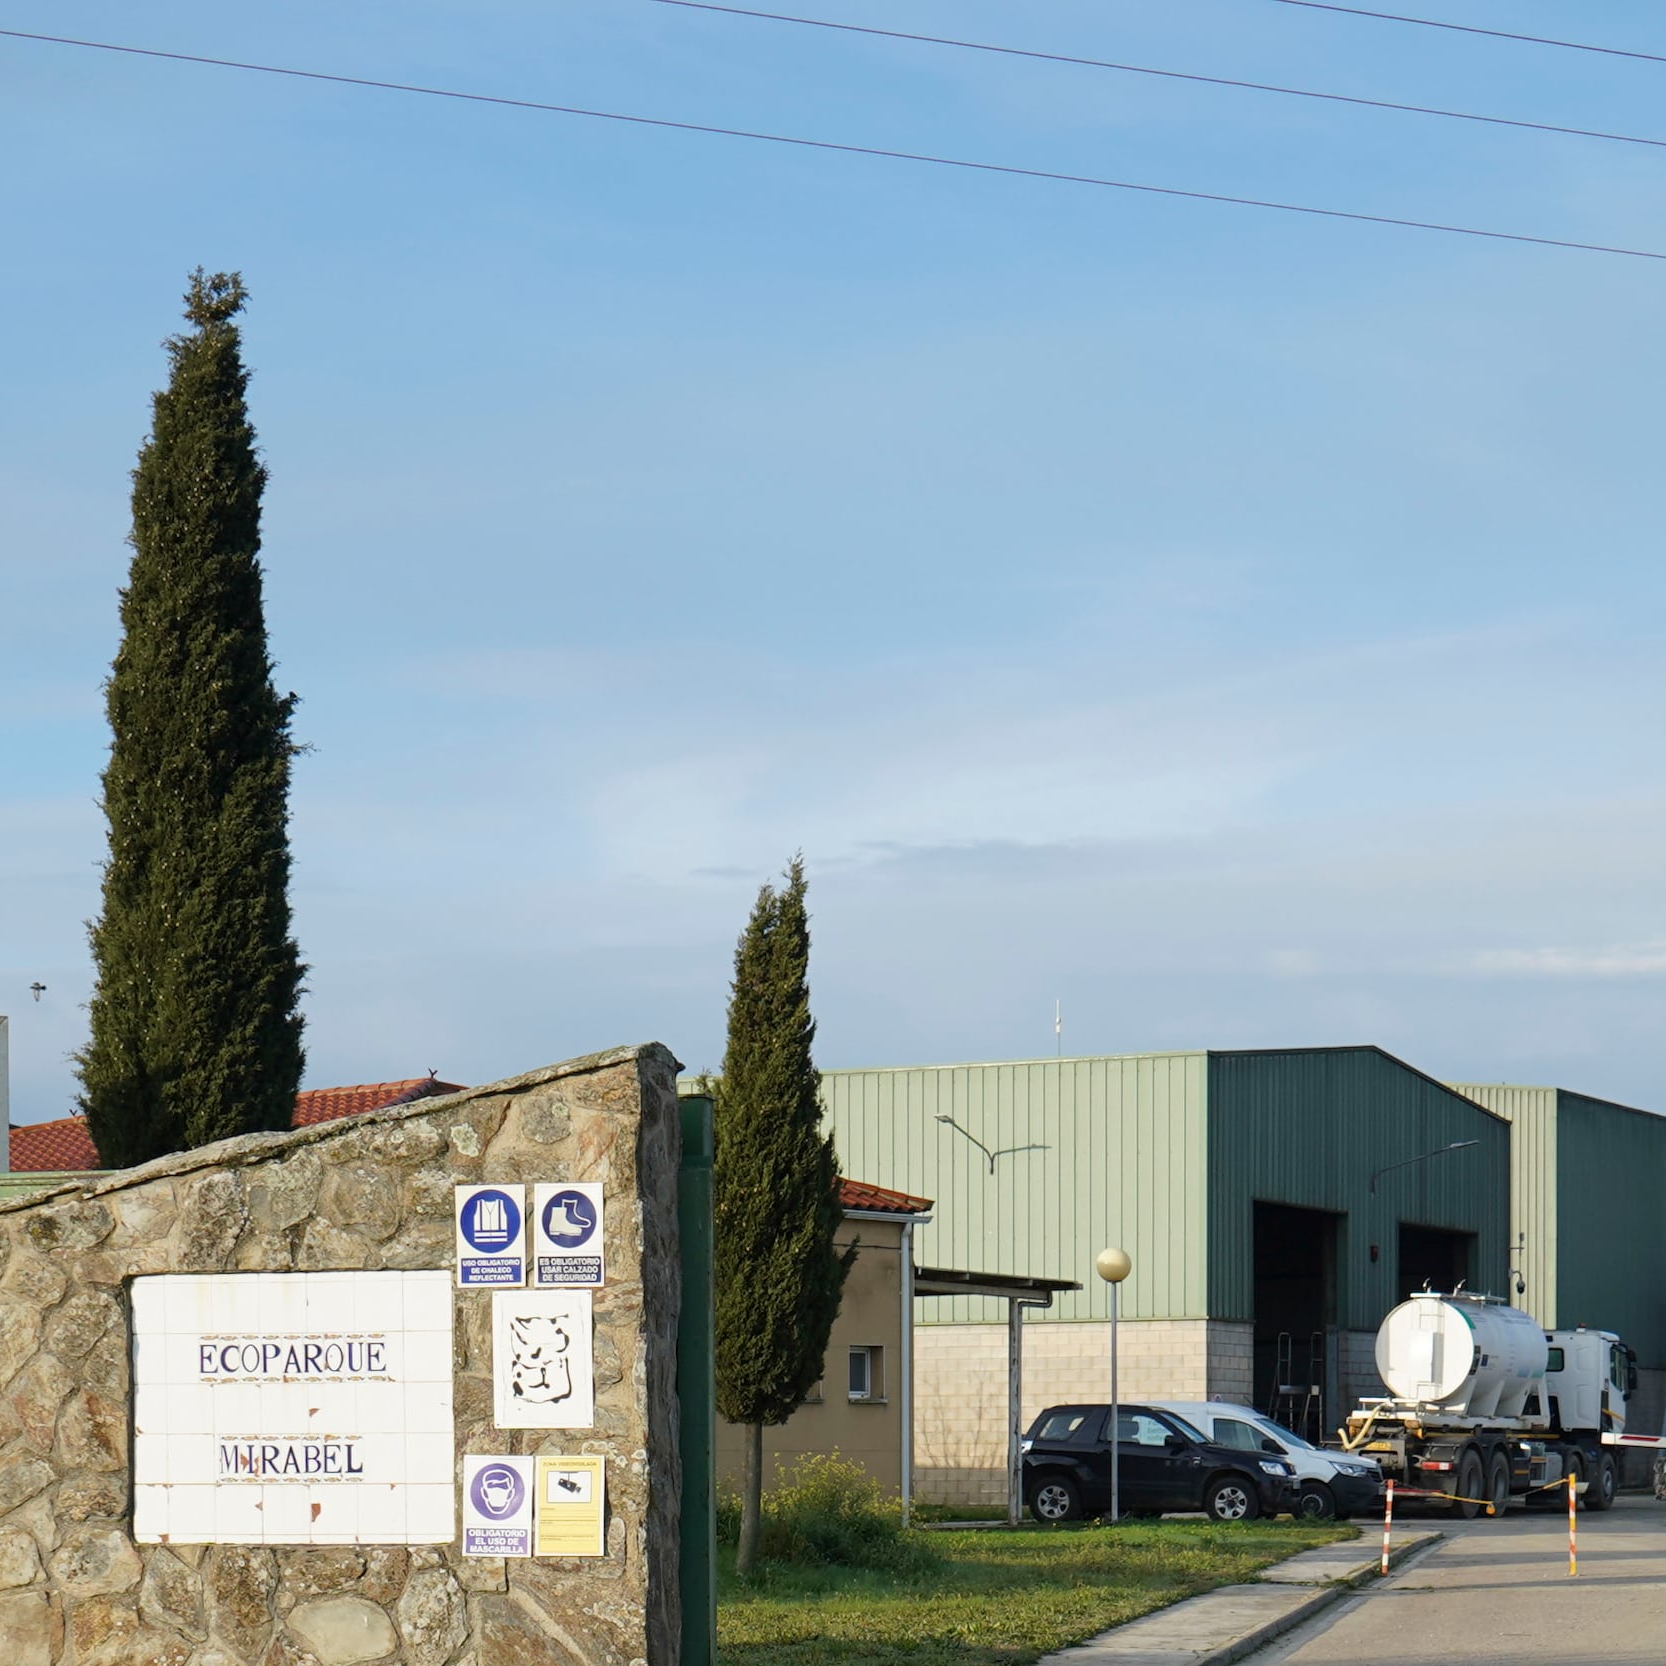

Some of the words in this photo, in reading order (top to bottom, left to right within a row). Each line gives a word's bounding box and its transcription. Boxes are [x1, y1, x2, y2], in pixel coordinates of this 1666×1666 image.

[462, 1259, 476, 1267] USO
[477, 1259, 521, 1267] OBLIGATORIO
[539, 1258, 550, 1266] ES
[551, 1258, 600, 1266] OBLIGATORIO
[541, 1266, 562, 1274] USAR
[563, 1266, 599, 1274] CALZADO
[469, 1274, 514, 1282] REFLECTANTE
[542, 1274, 553, 1282] DE
[554, 1274, 597, 1282] SEGURIDAD
[199, 1342, 387, 1374] ECOPARQUE
[220, 1444, 364, 1475] MIRABEL
[468, 1529, 526, 1538] OBLIGATORIO
[475, 1537, 486, 1545] EL
[487, 1537, 506, 1545] USO
[509, 1537, 519, 1545] DE
[469, 1545, 524, 1553] MASCARILLA
